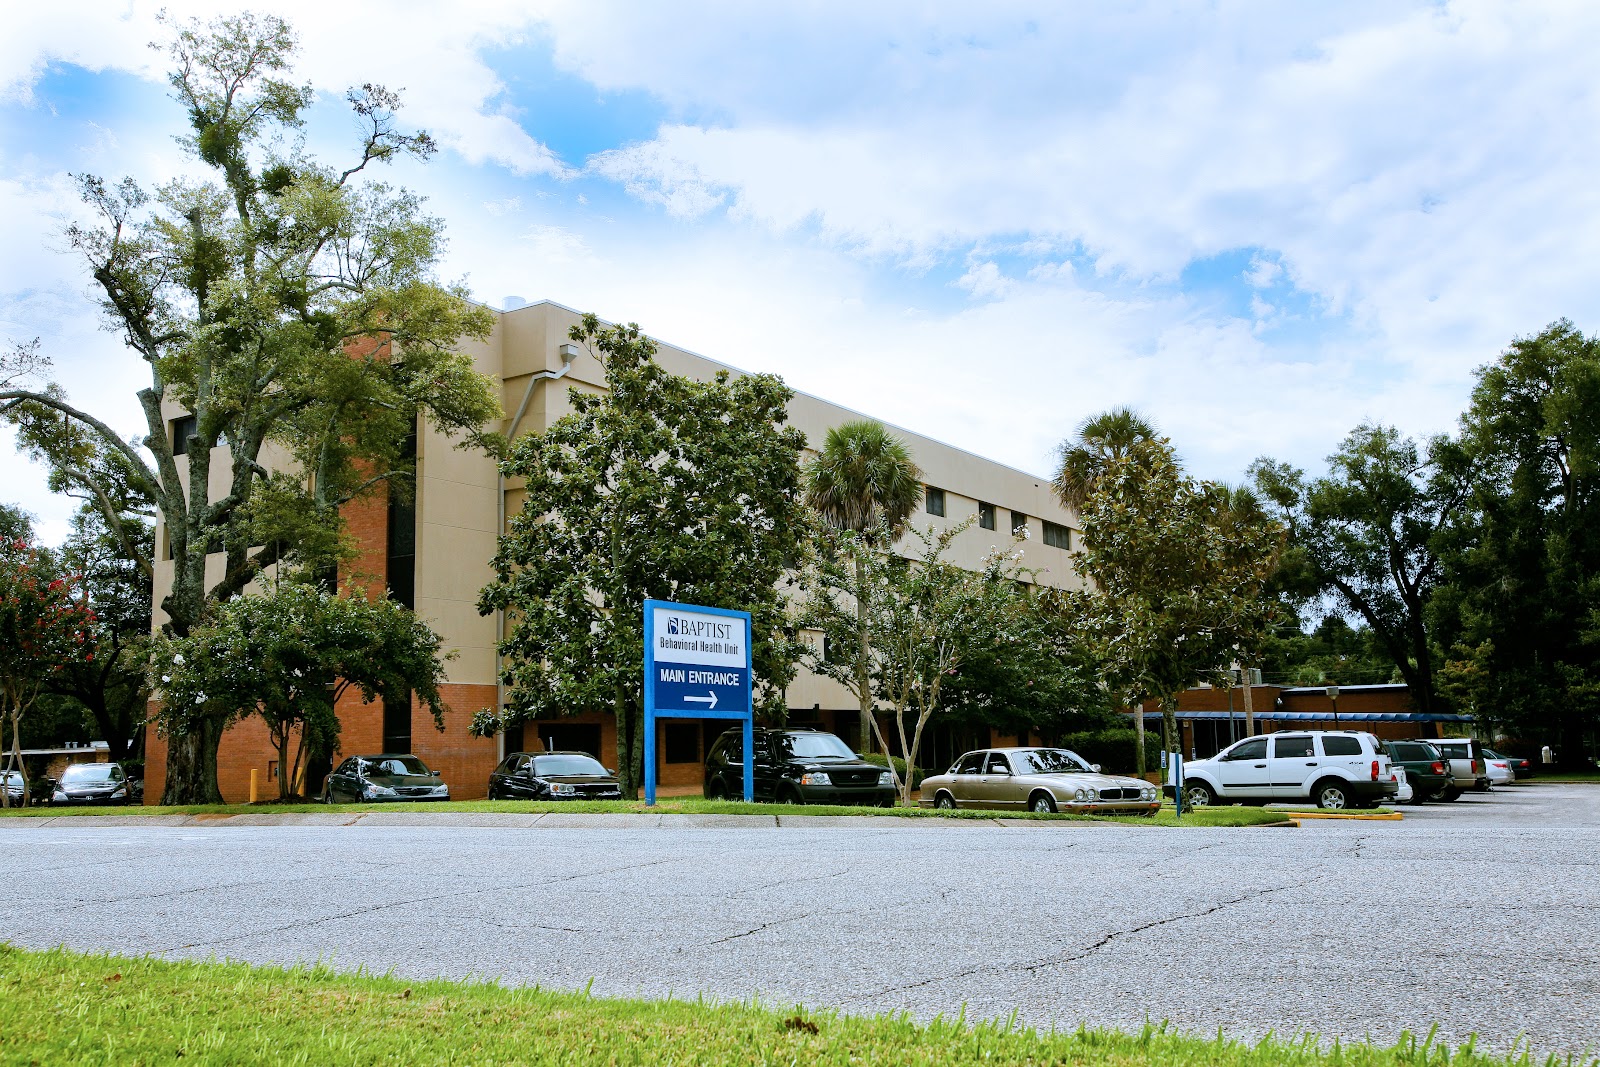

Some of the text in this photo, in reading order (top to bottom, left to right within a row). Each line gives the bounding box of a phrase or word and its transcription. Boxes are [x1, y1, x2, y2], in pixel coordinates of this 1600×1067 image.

[681, 619, 732, 640] BAPTIST
[660, 636, 739, 655] Behavioral Health Unit
[660, 668, 740, 686] MAIN ENTRANCE
